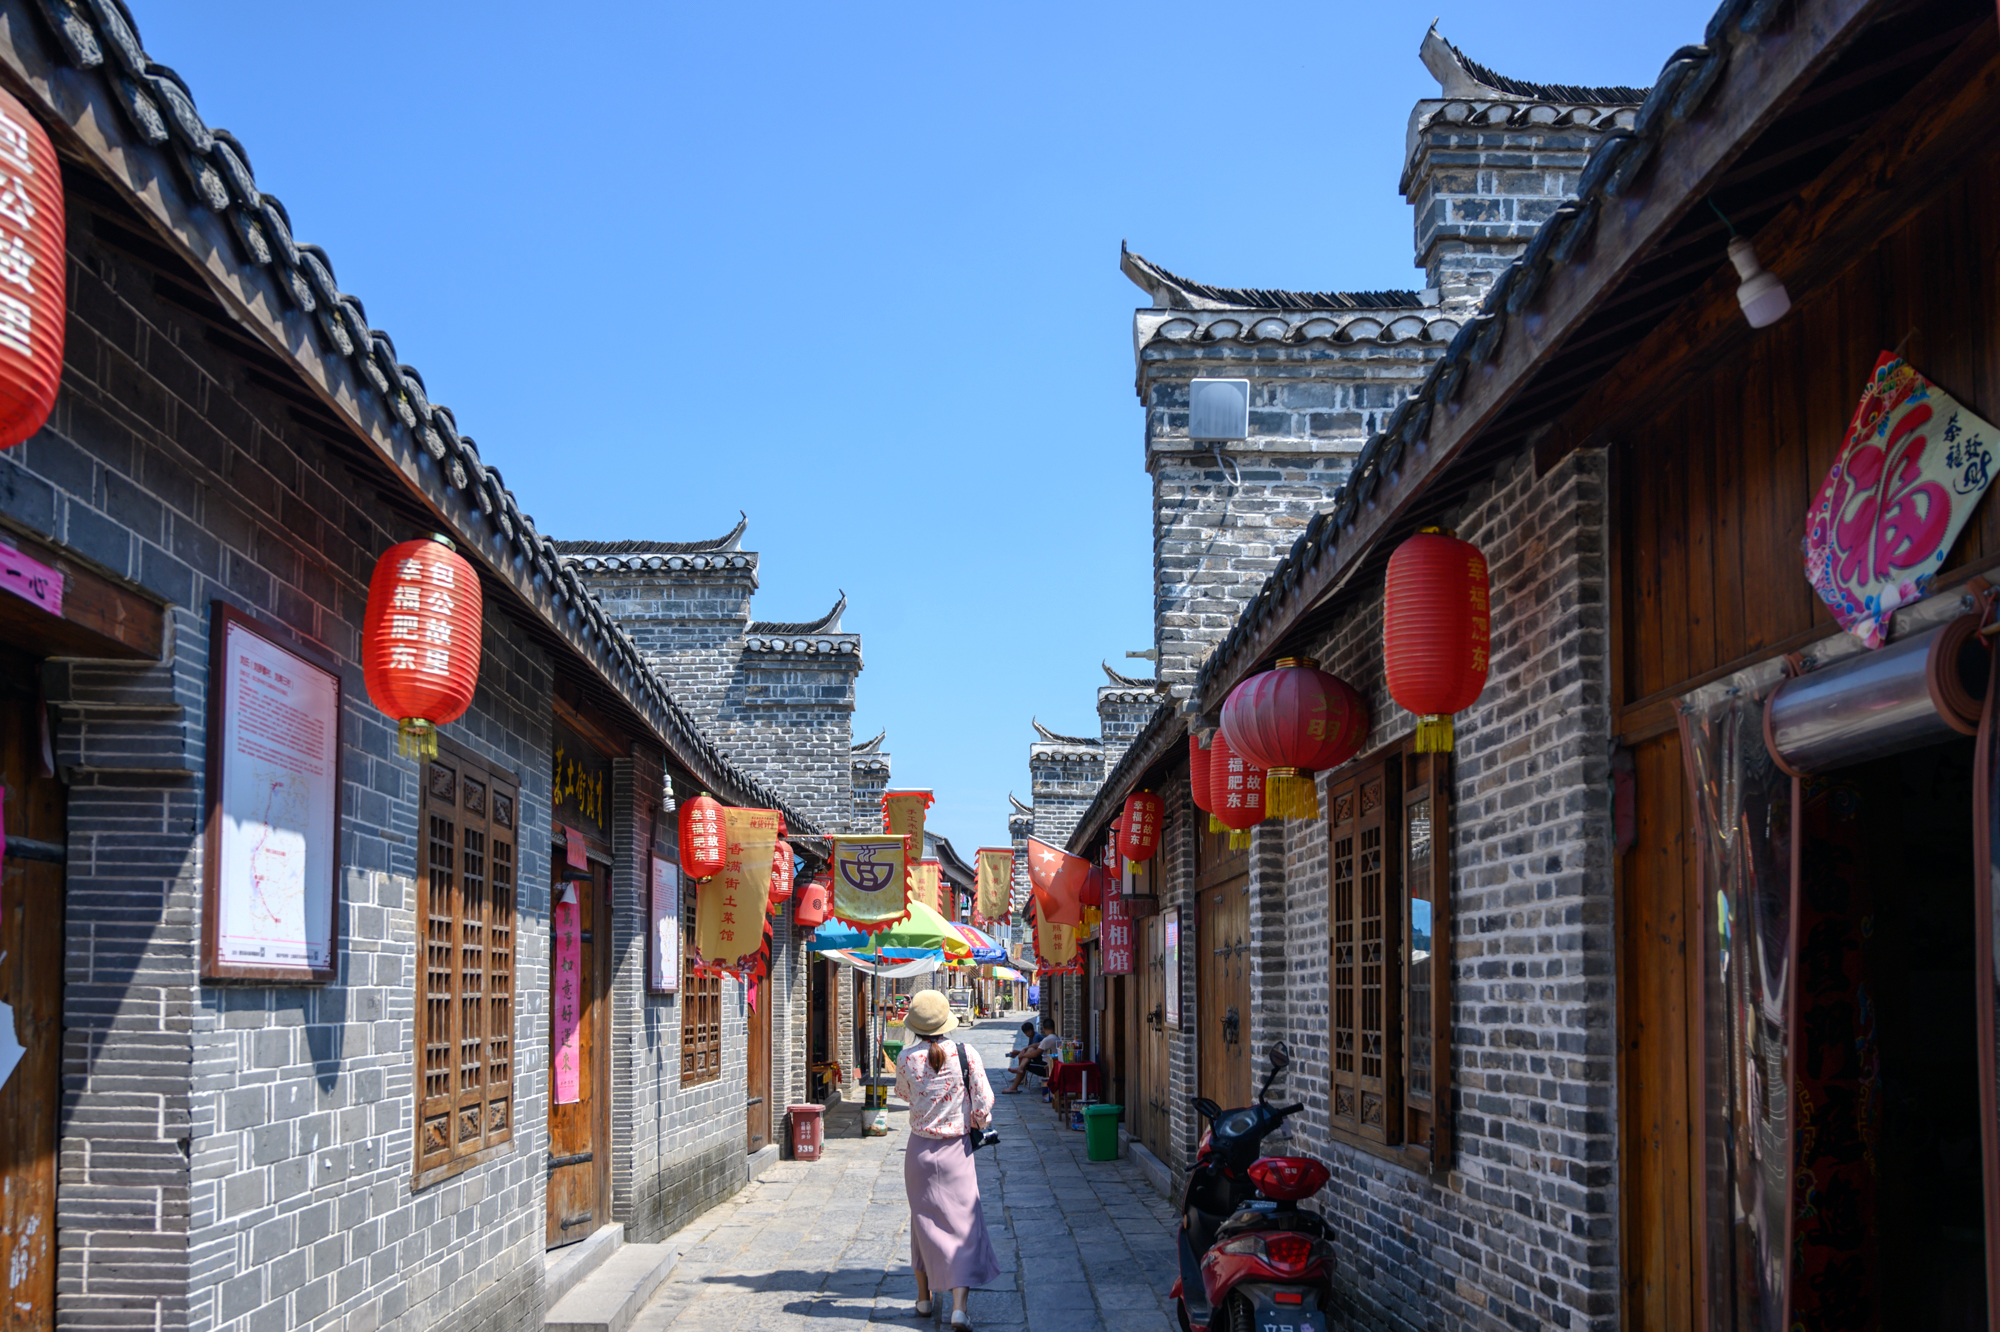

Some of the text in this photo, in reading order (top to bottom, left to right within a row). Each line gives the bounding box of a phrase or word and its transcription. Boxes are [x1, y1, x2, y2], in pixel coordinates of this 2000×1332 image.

[389, 558, 424, 670] 幸福肥东
[421, 561, 456, 676] 包公故里
[1467, 556, 1488, 672] 幸福肥东
[1307, 692, 1344, 743] 文明
[1226, 750, 1244, 809] 福肥东
[691, 809, 706, 861] 幸福肥东
[705, 809, 720, 861] 包公故里
[1130, 800, 1144, 846] 幸福肥东
[1141, 801, 1155, 847] 包公故里
[719, 843, 744, 942] 香满街土菜馆
[561, 906, 573, 1074] 萬事如意好運來
[797, 1144, 814, 1153] 339
